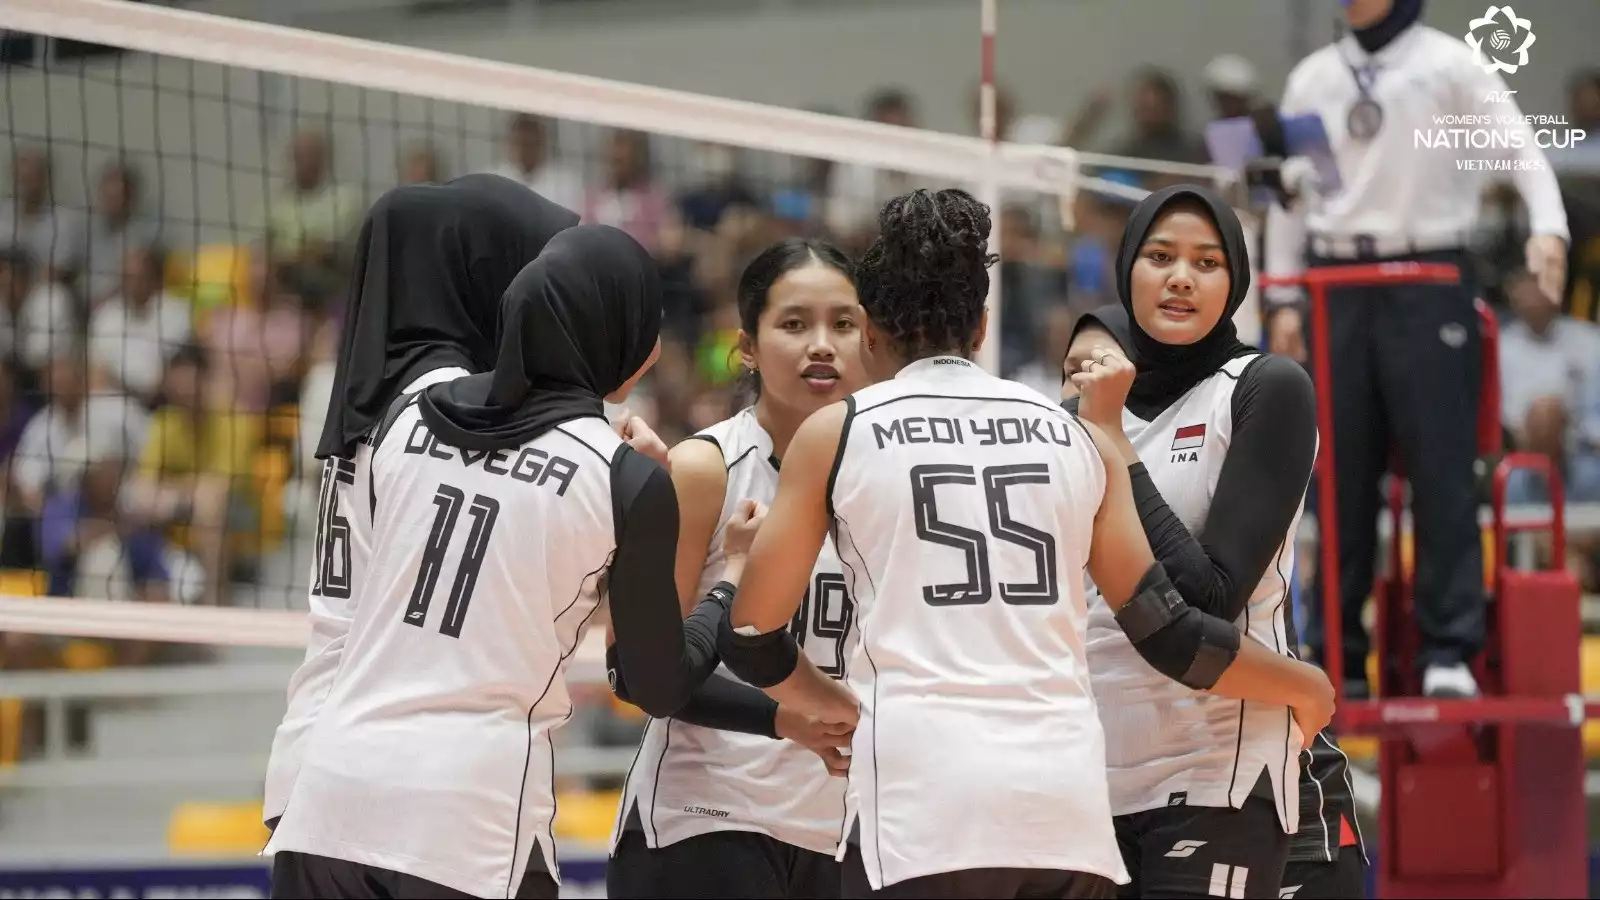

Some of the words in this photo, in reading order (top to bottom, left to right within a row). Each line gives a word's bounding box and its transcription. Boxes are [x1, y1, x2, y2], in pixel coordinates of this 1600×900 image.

[933, 358, 971, 368] INDONESIA
[871, 416, 964, 450] MEDI
[970, 417, 1072, 447] YOKU
[1170, 451, 1198, 463] INA
[909, 463, 1059, 607] 55
[403, 483, 500, 639] 11
[684, 805, 731, 818] ULTRADRY
